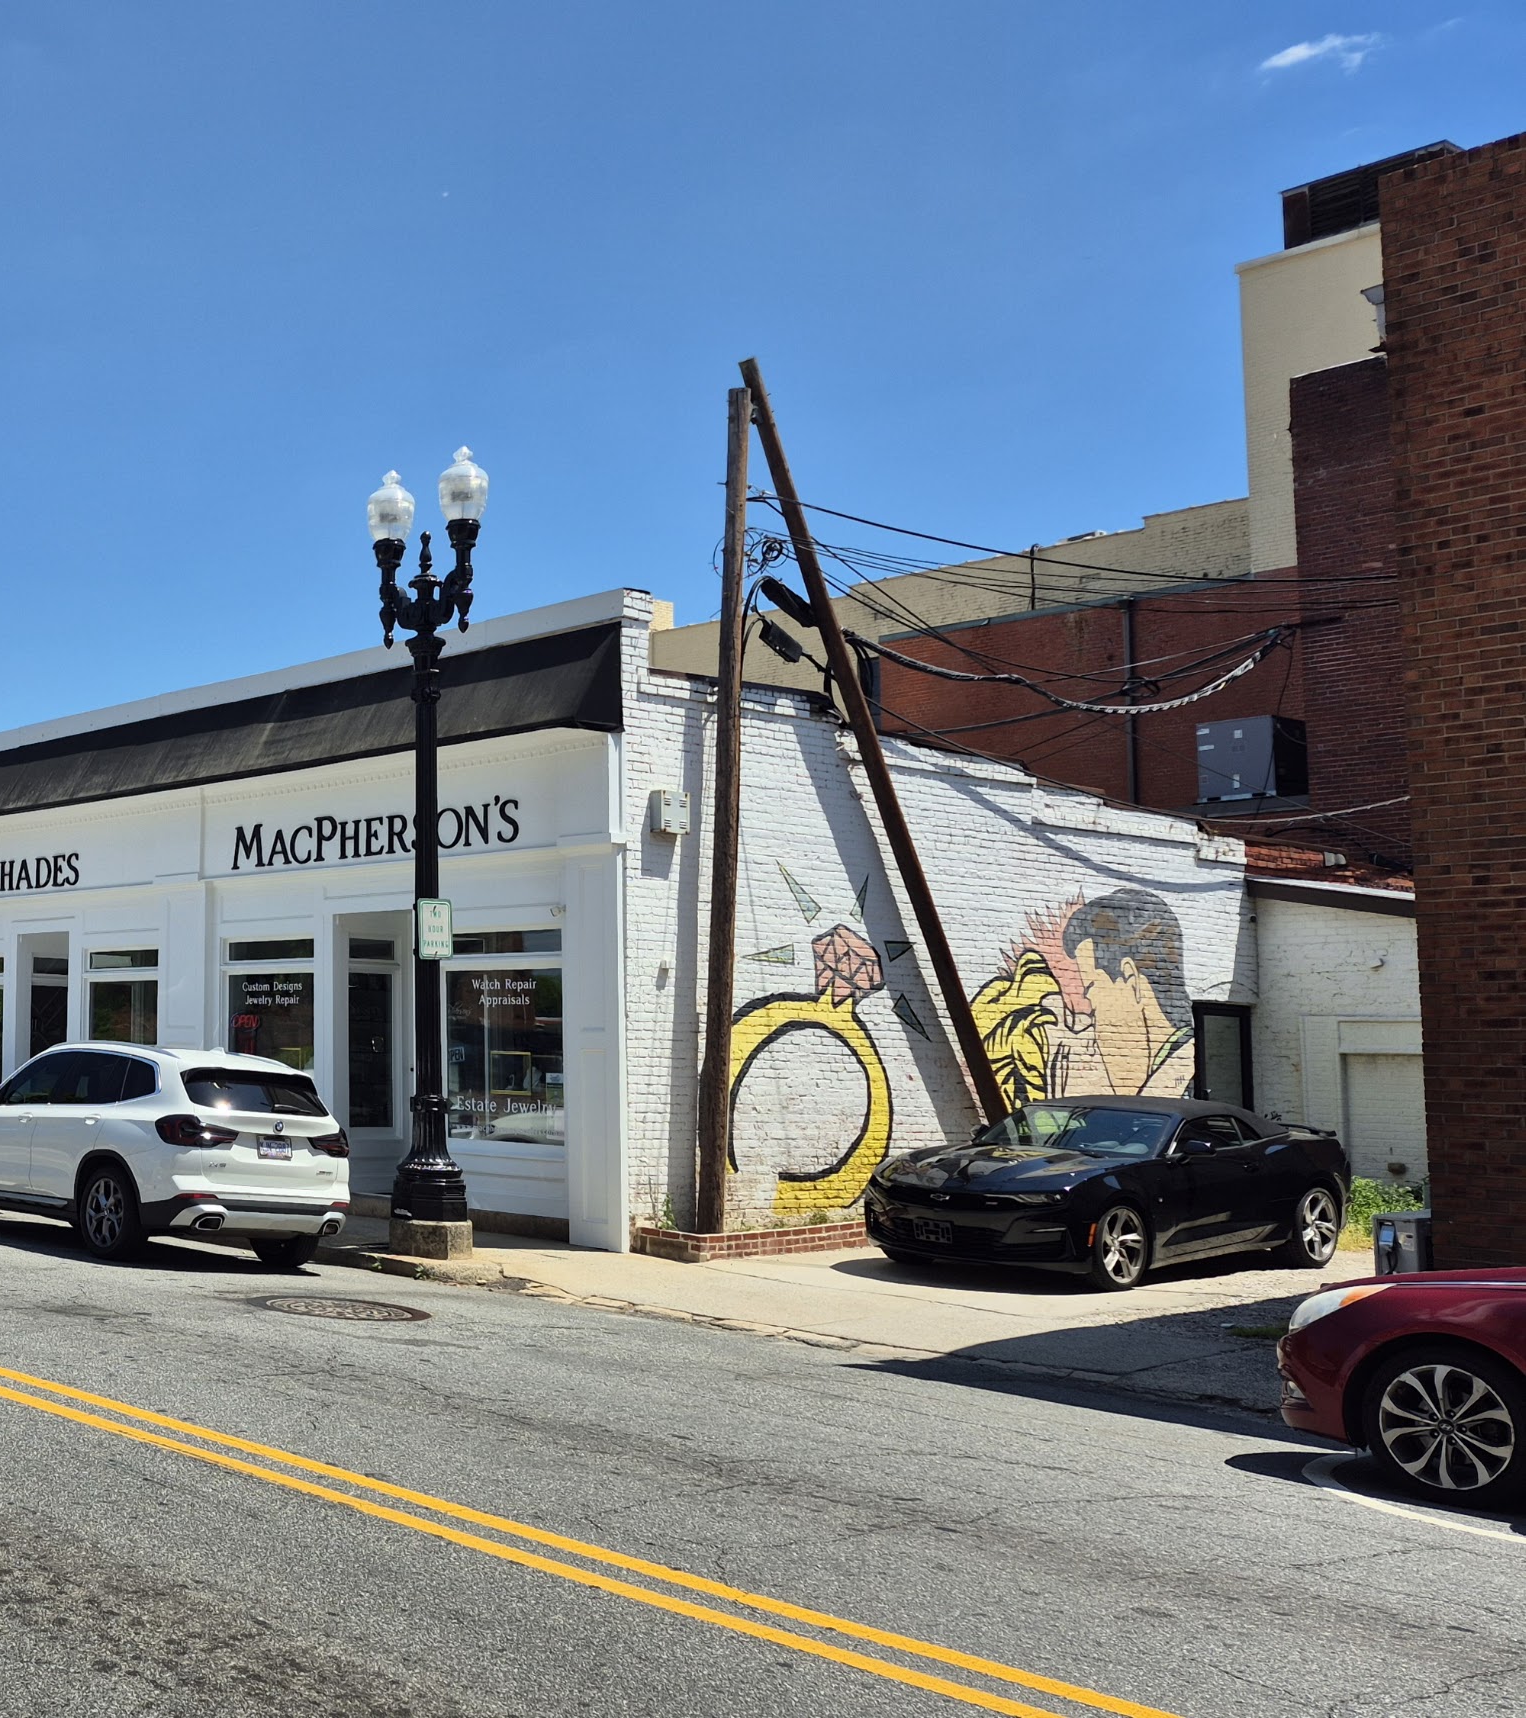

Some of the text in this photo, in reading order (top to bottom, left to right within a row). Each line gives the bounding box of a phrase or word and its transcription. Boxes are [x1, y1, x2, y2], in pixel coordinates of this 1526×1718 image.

[231, 795, 520, 870] MACPHERON'S
[428, 925, 443, 933] HOUR
[423, 940, 449, 948] PARKING
[242, 981, 303, 993] Custom Designs
[471, 979, 537, 992] Watch Repair
[245, 994, 300, 1007] Jewelry Repair
[478, 994, 531, 1007] Appraisals
[233, 1014, 258, 1028] OPEN
[456, 1096, 557, 1115] Estate Jewelry
